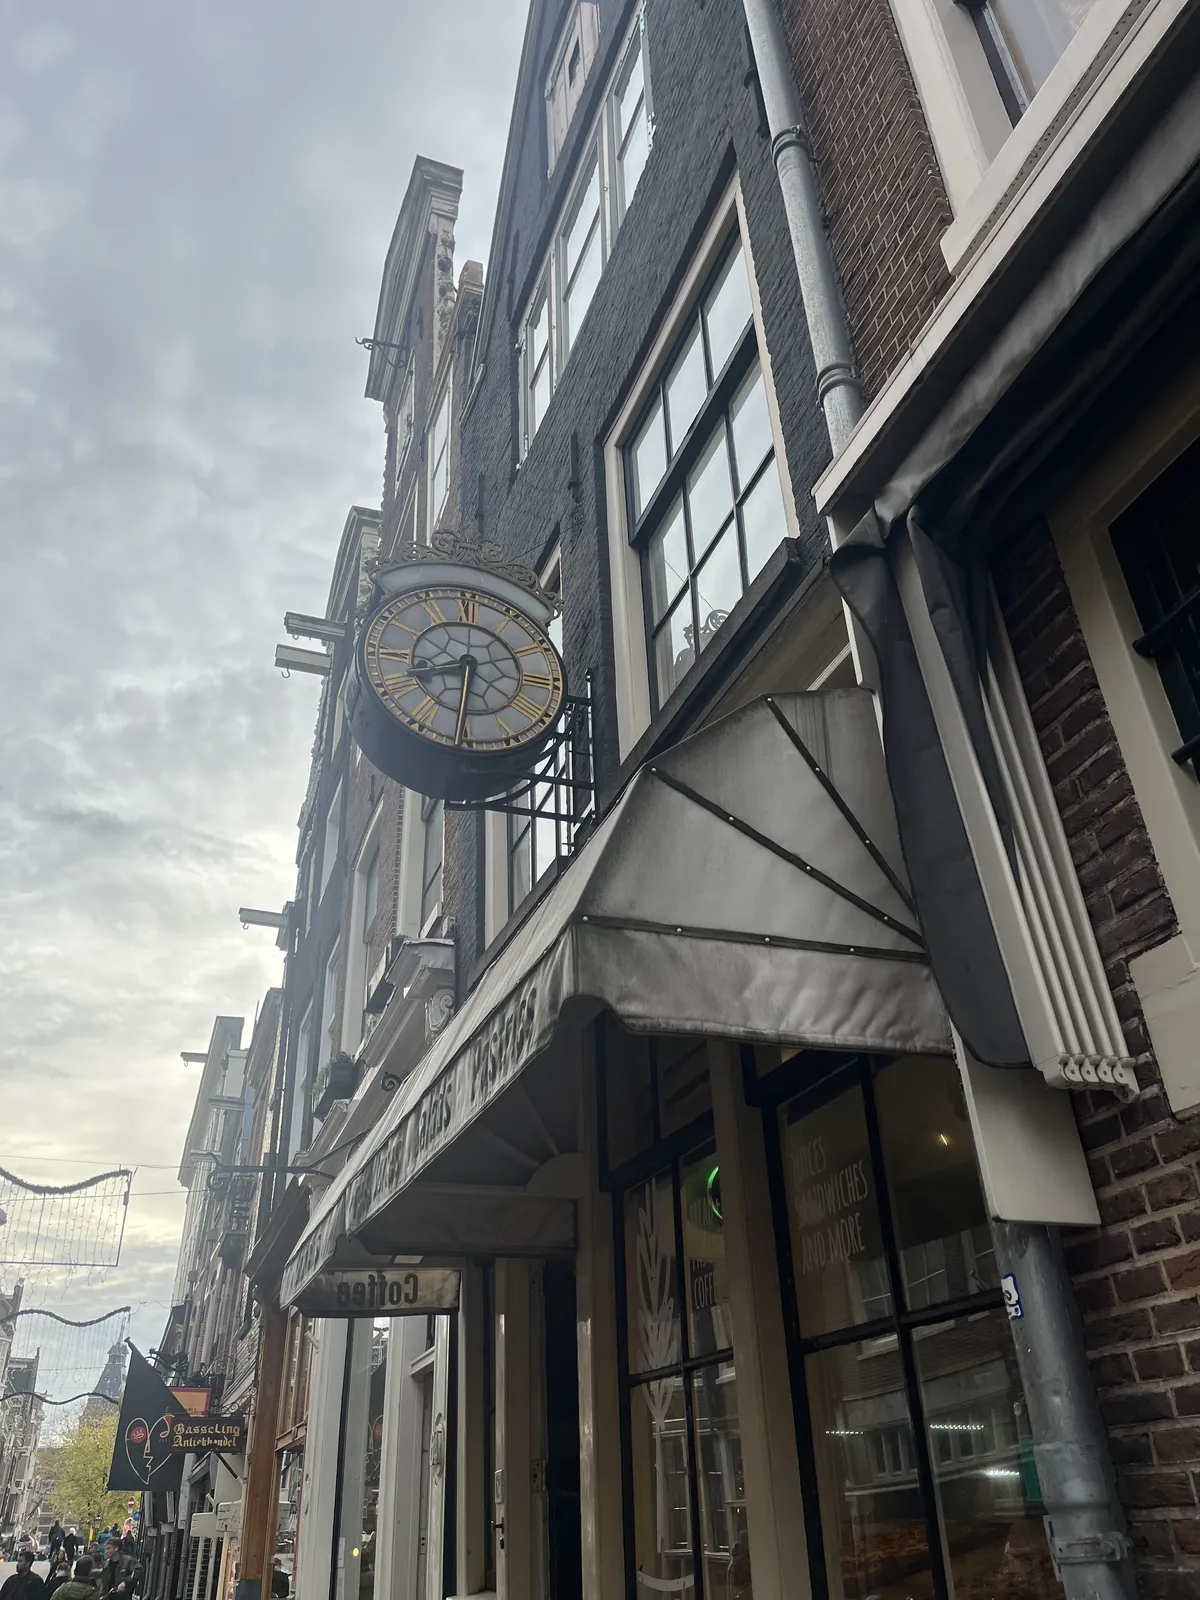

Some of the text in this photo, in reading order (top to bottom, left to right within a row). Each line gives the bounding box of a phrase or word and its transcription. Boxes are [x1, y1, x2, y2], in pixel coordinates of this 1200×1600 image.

[457, 599, 479, 625] XII
[383, 672, 419, 701] VIII
[522, 672, 551, 690] III
[410, 694, 440, 728] VII
[790, 1135, 827, 1190] JUICES
[795, 1159, 868, 1229] SANDWICHES
[801, 1212, 865, 1275] AND MORE
